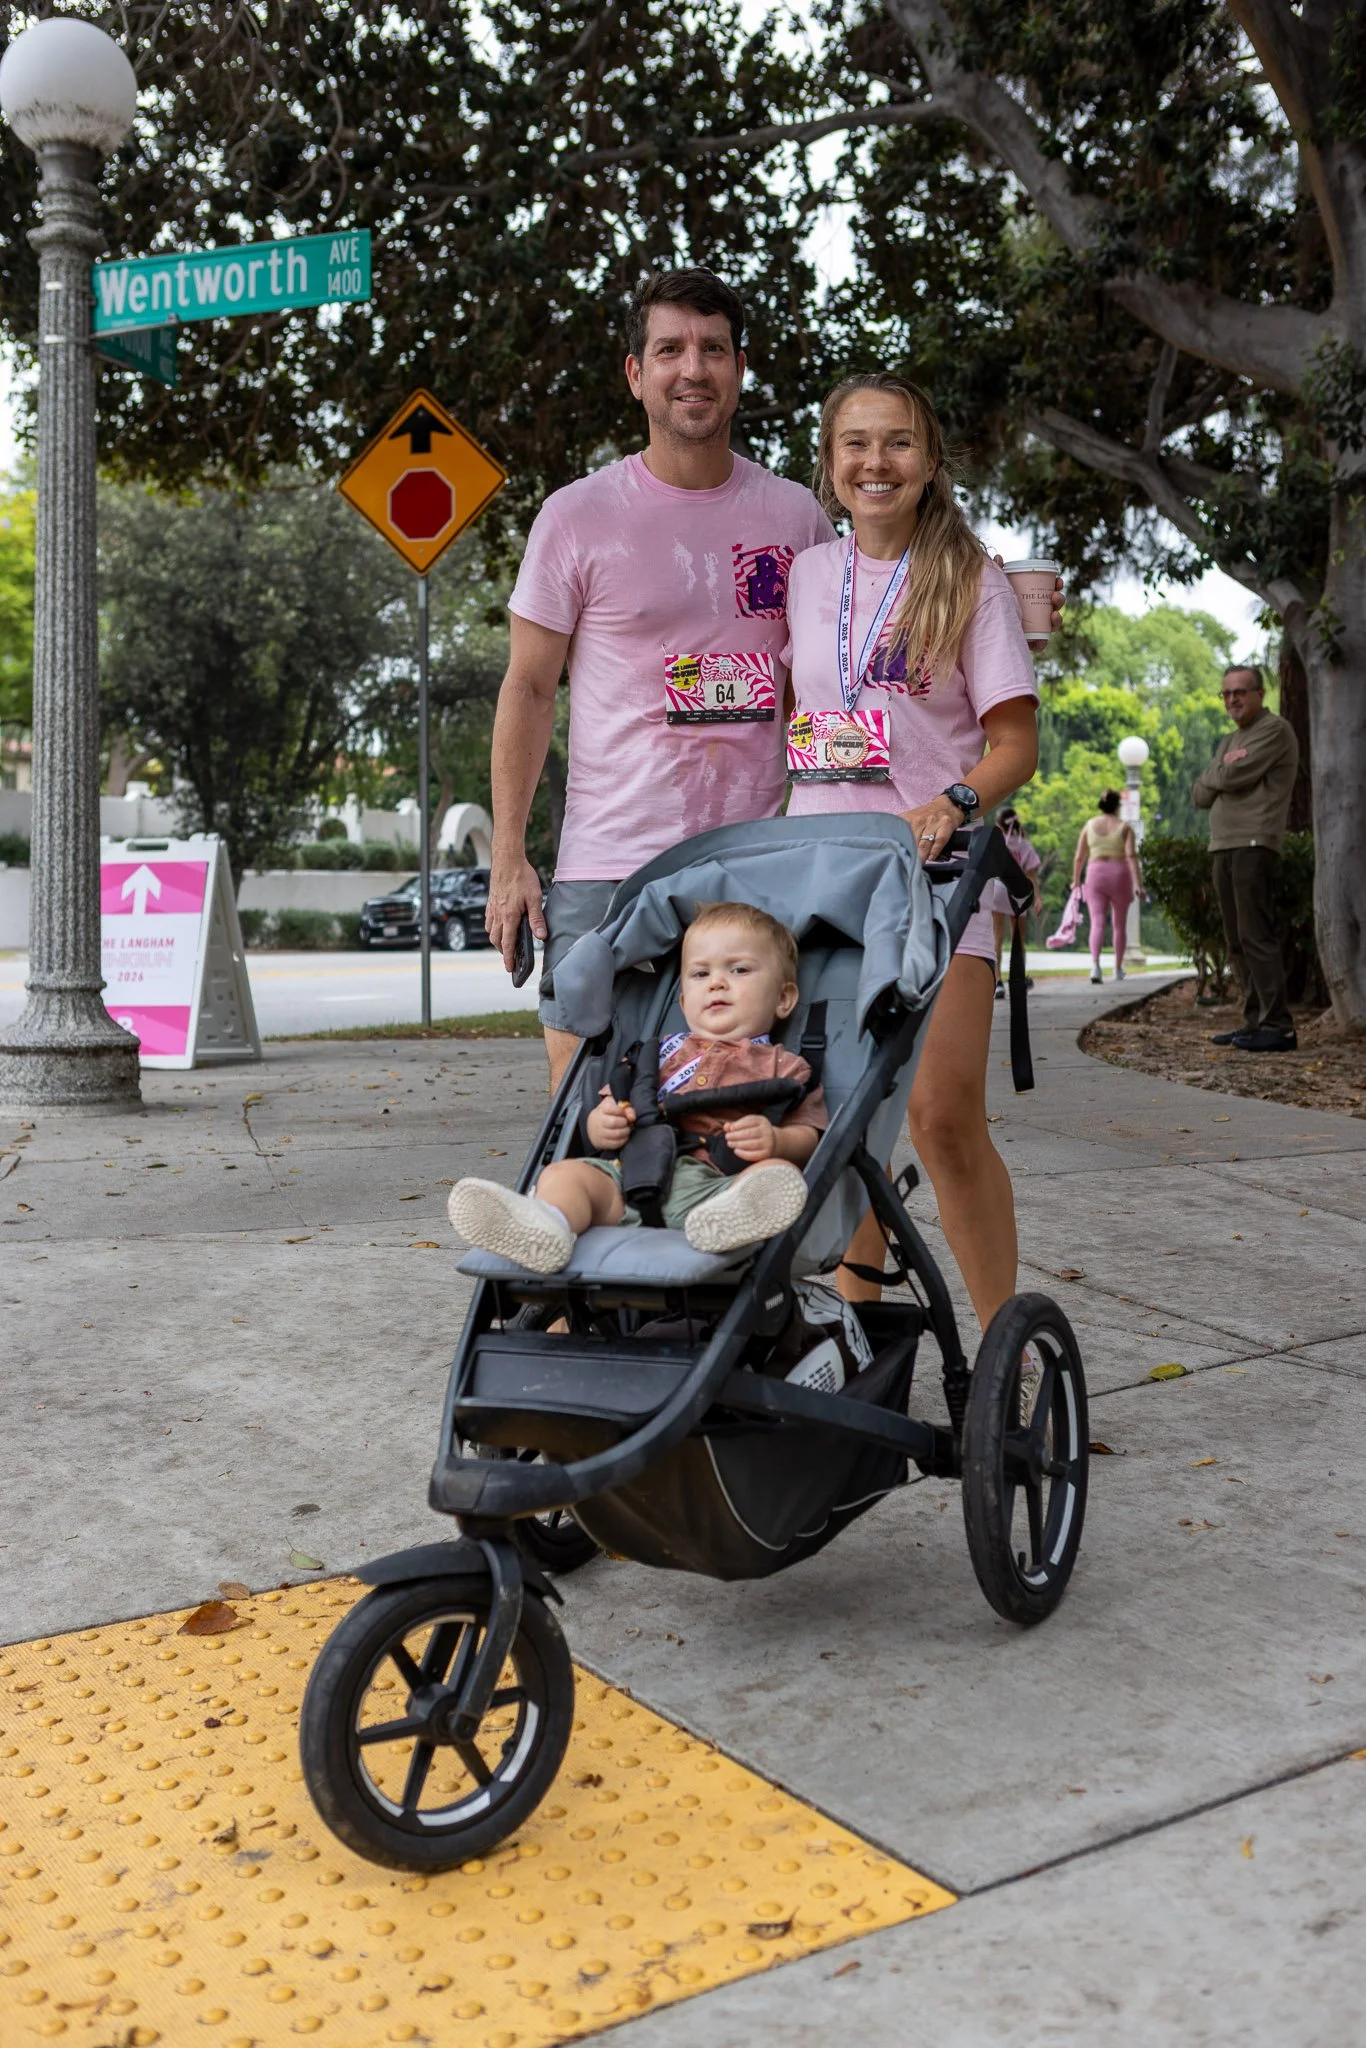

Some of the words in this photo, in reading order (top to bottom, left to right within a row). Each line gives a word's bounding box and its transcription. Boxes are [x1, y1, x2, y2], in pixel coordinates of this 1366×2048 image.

[329, 237, 360, 265] AVE
[100, 247, 307, 316] Wentworth
[327, 268, 362, 297] 1400
[716, 684, 735, 703] 64
[103, 937, 116, 949] HE
[121, 936, 175, 949] LANGHAM
